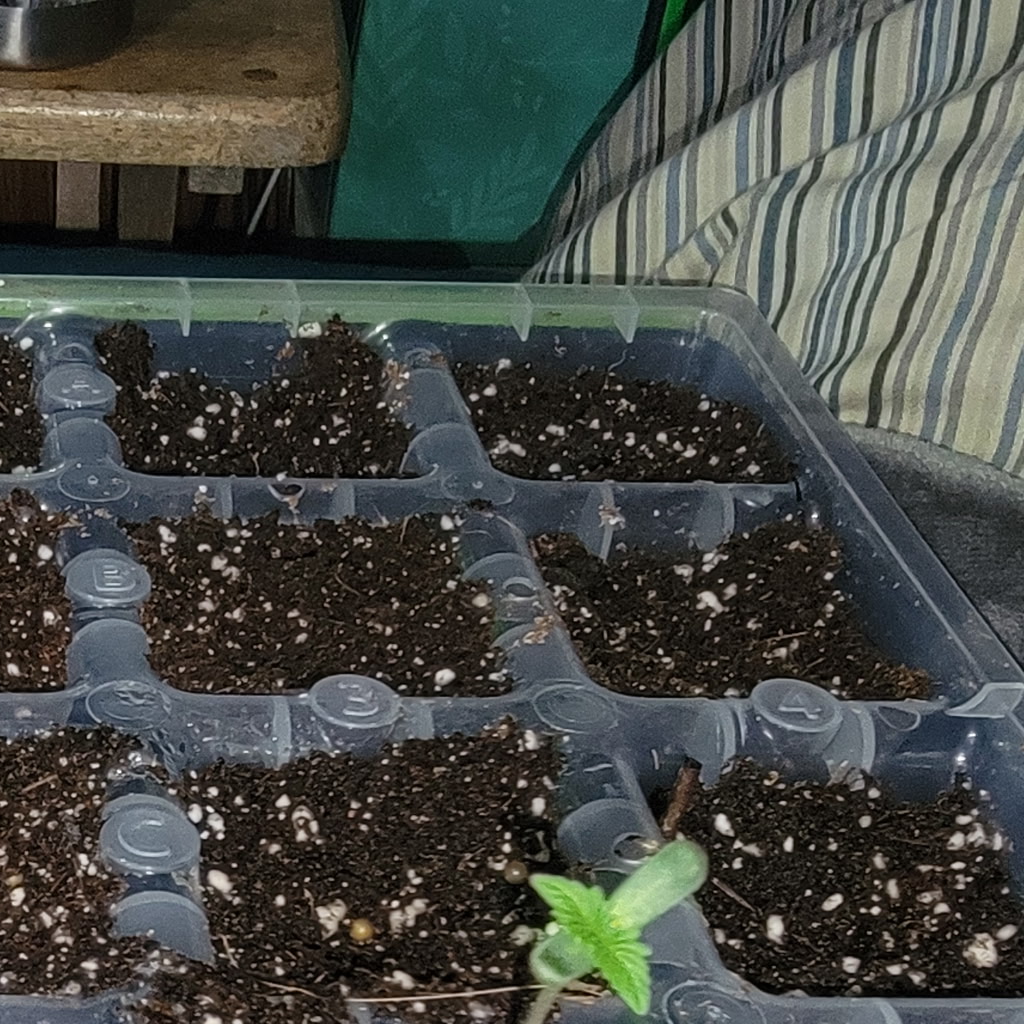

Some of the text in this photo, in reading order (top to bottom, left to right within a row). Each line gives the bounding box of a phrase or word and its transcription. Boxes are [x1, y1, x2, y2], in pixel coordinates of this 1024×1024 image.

[92, 563, 136, 592] B
[337, 682, 379, 717] 3
[778, 684, 822, 720] 4
[117, 814, 172, 858] C
